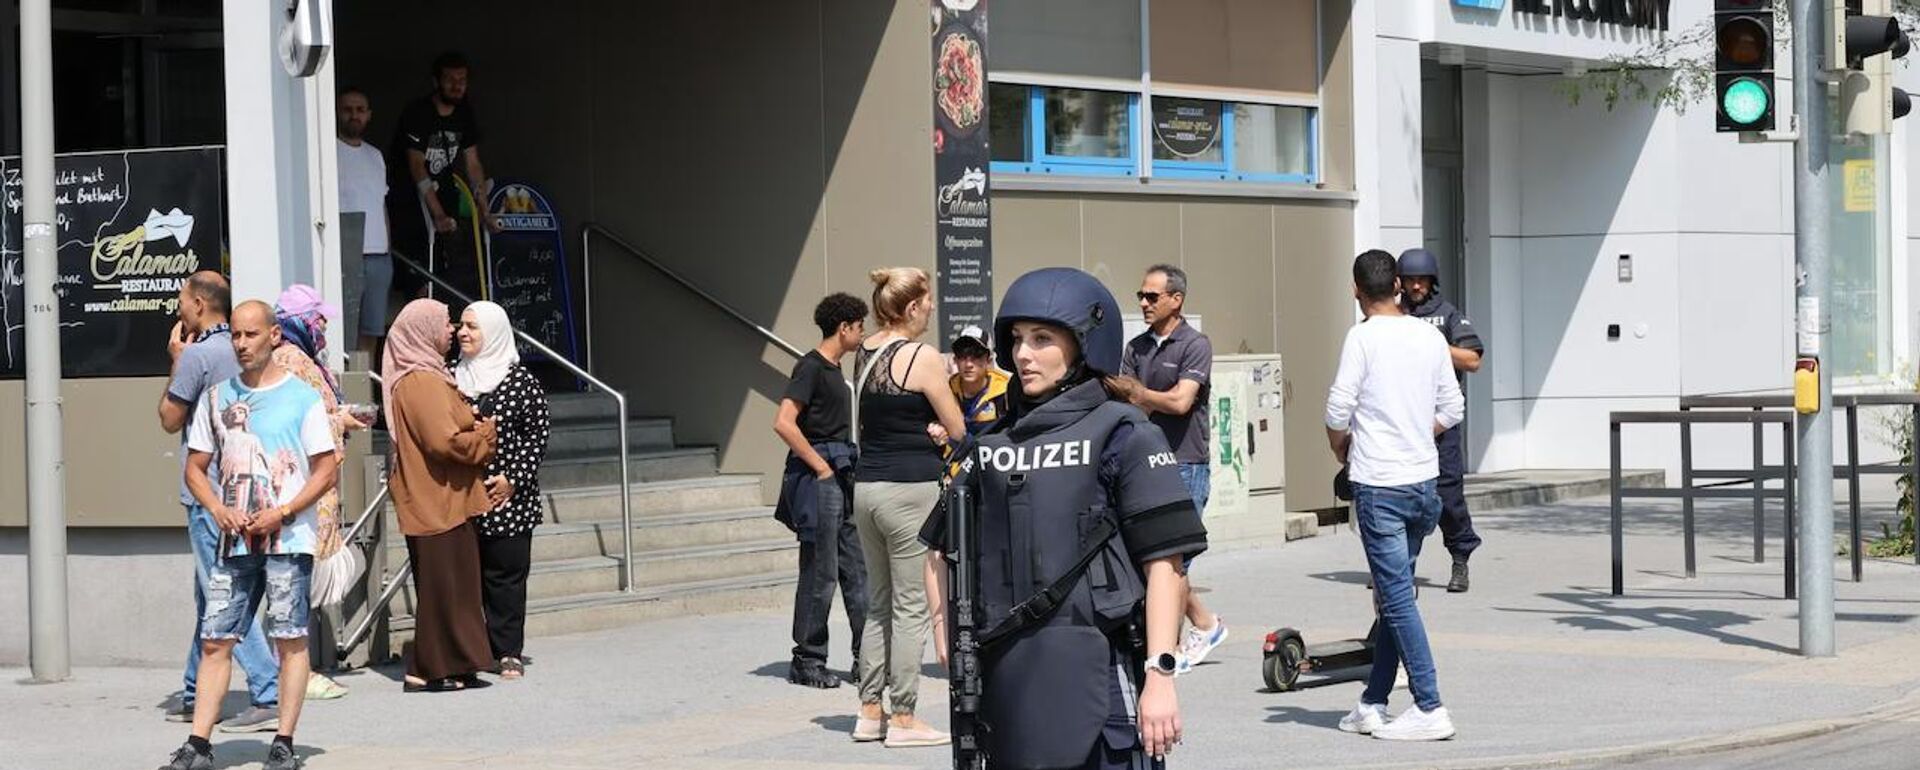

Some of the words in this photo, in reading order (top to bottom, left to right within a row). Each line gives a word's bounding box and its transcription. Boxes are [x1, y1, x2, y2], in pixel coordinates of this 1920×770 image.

[91, 235, 199, 281] Calamar
[121, 278, 187, 293] RESTAURA
[84, 295, 180, 315] www.calamar-gr
[978, 440, 1091, 472] POLIZEI
[1148, 452, 1177, 469] POLI
